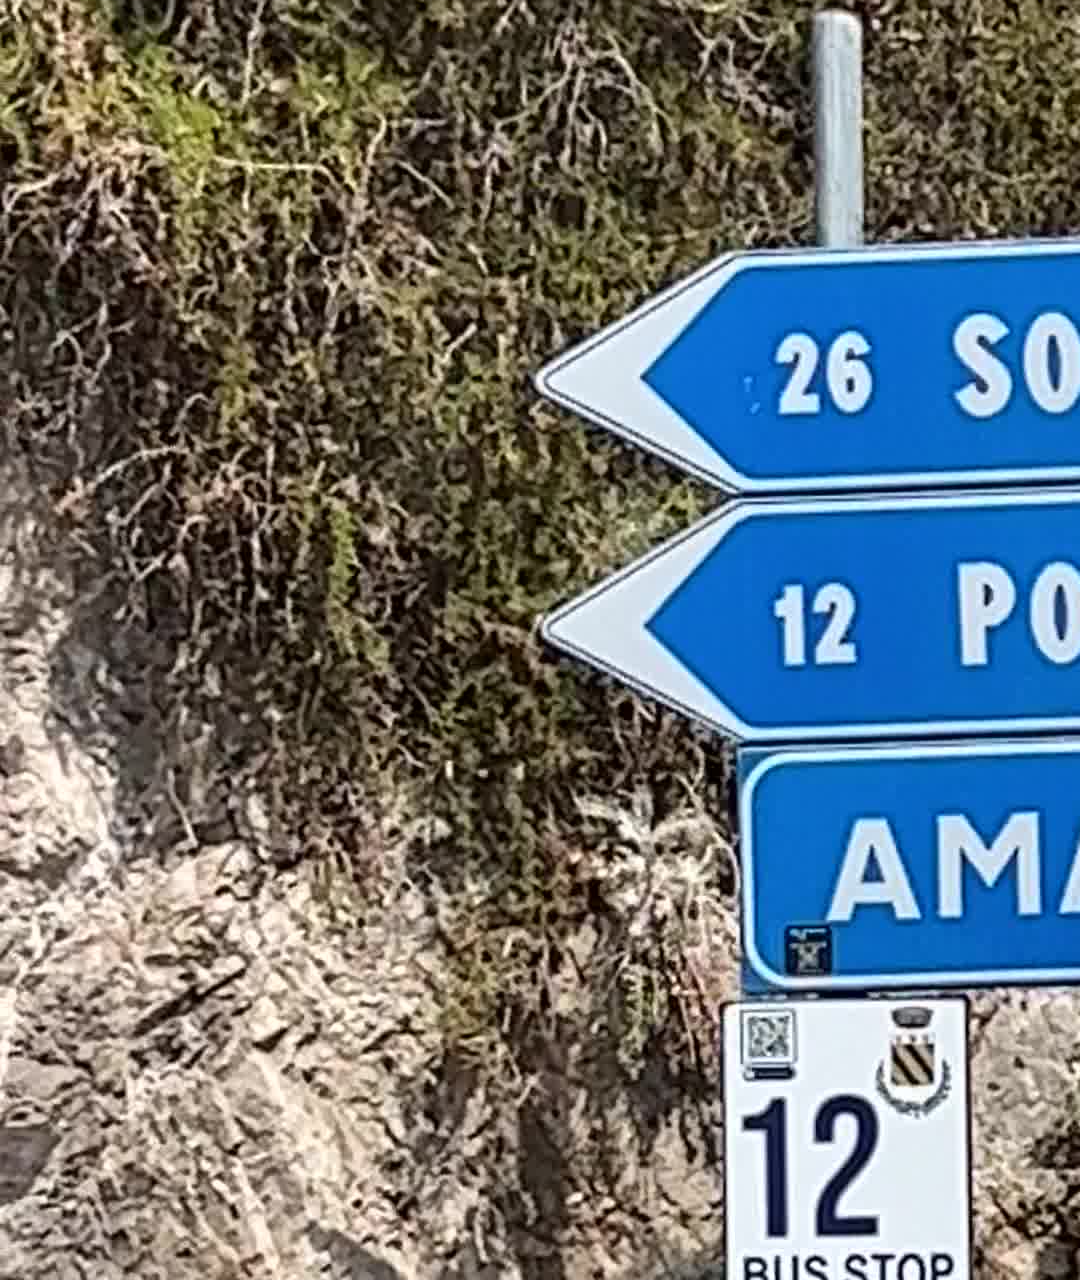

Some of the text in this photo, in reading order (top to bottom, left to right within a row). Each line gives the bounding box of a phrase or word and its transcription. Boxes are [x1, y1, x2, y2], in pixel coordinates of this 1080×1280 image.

[775, 329, 874, 416] 26
[774, 582, 859, 667] 12
[741, 1093, 880, 1238] 12
